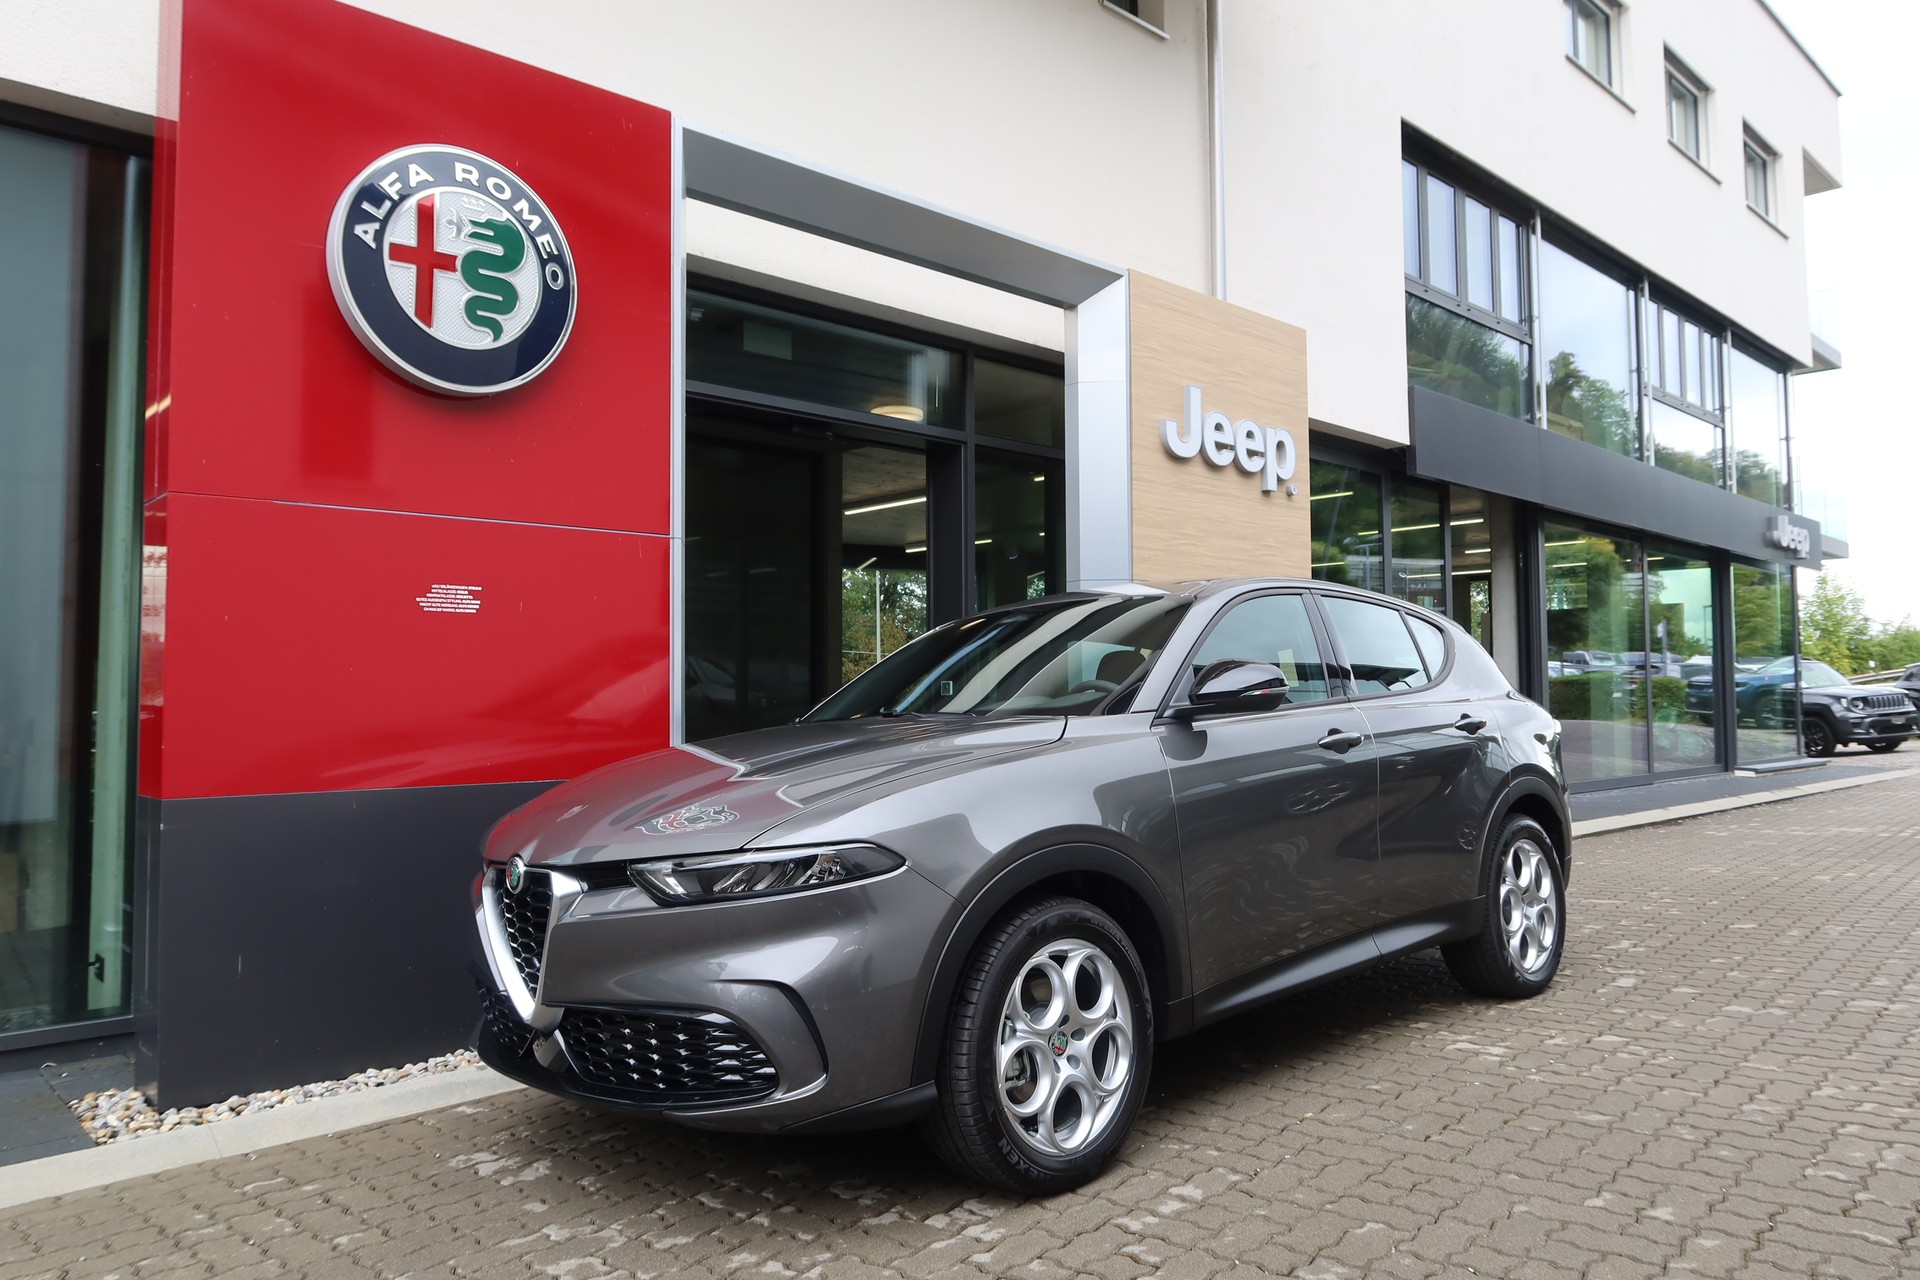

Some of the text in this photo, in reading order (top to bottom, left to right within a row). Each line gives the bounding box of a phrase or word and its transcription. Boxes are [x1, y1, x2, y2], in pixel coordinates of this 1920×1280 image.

[353, 161, 564, 291] ALFA ROMEO
[1160, 384, 1297, 493] Jeep
[1770, 514, 1810, 559] Jeep
